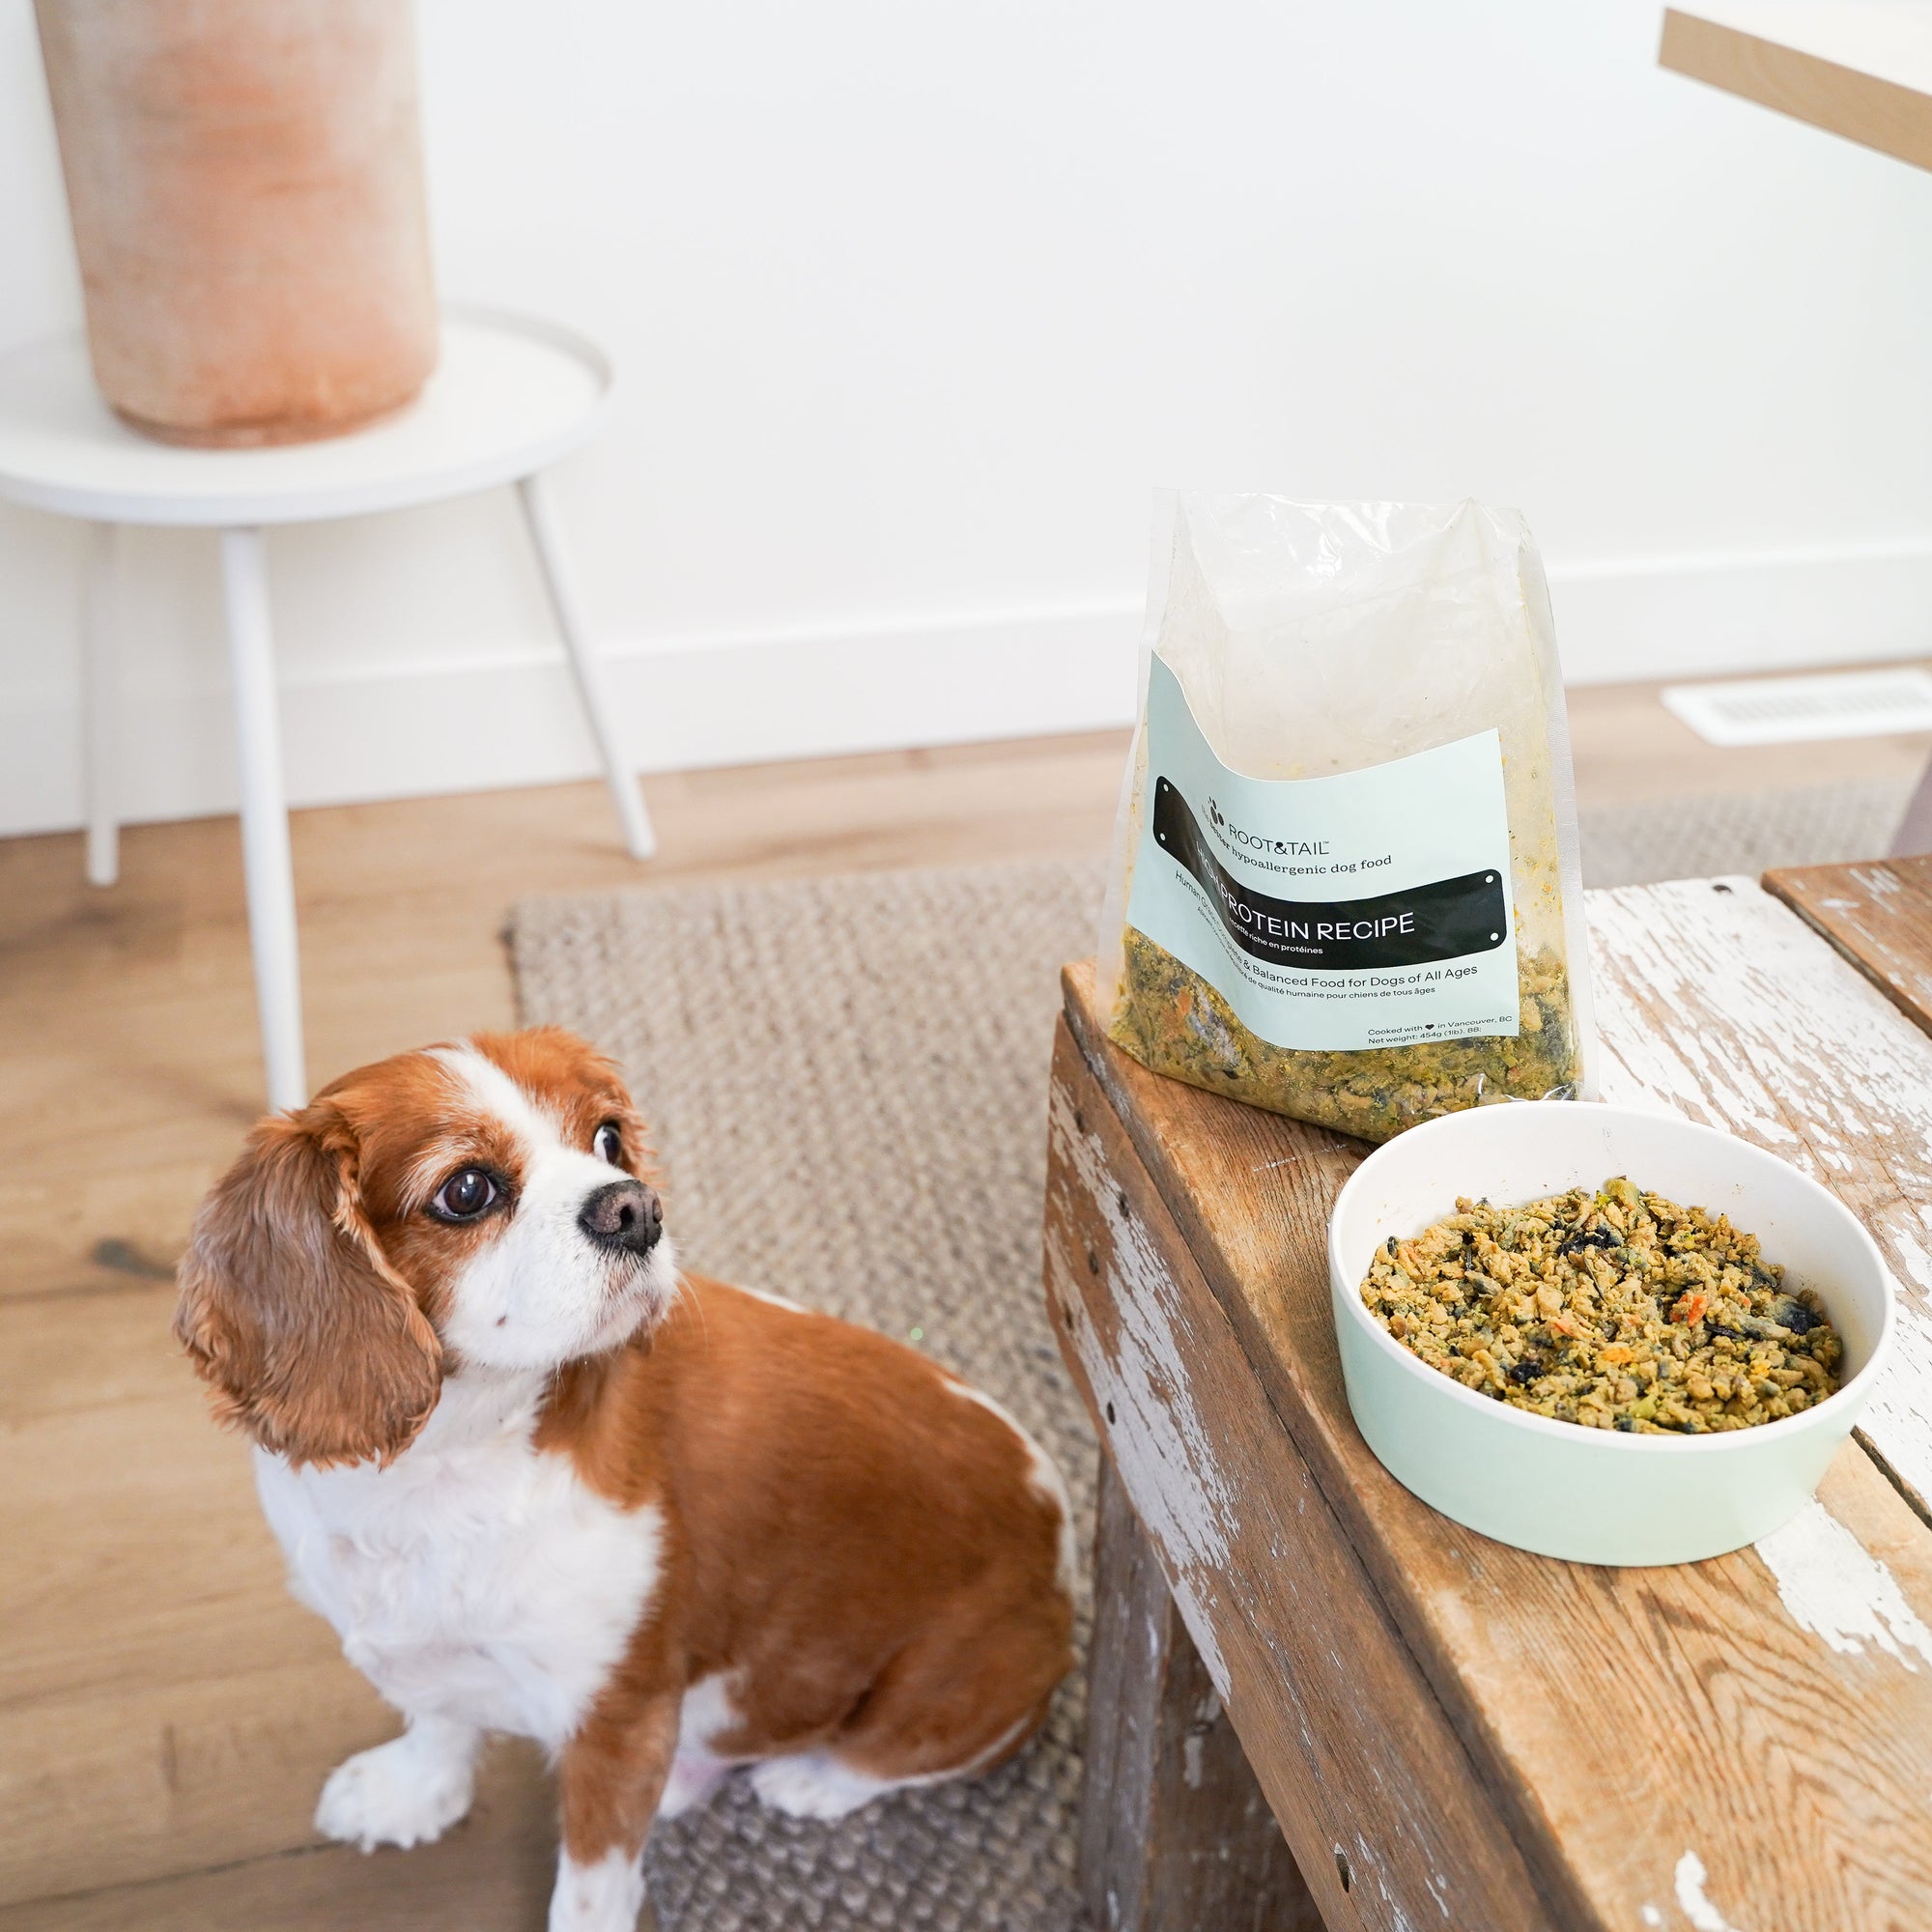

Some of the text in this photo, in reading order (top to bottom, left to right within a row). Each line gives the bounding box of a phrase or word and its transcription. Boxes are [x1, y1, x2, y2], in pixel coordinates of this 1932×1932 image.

[1232, 845, 1326, 875] hypoallergenic
[1330, 864, 1357, 873] dog
[1360, 855, 1392, 869] food
[1220, 883, 1309, 940] PROTEIN
[1317, 911, 1415, 941] RECIPE
[1175, 870, 1202, 901] Human
[1243, 959, 1252, 972] &
[1253, 964, 1308, 986] Balanced
[1311, 977, 1345, 988] Food
[1348, 977, 1367, 987] for
[1370, 976, 1406, 987] Dogs
[1407, 973, 1422, 983] of
[1424, 970, 1441, 981] All
[1444, 966, 1478, 980] Ages
[1249, 933, 1268, 946] riche
[1281, 944, 1323, 954] protéines
[1258, 980, 1285, 995] qualité
[1286, 989, 1324, 999] humaine
[1349, 989, 1378, 999] chiens
[1368, 1027, 1403, 1036] Cooked
[1447, 1017, 1497, 1028] Vancouver,
[1386, 1034, 1418, 1042] weight:
